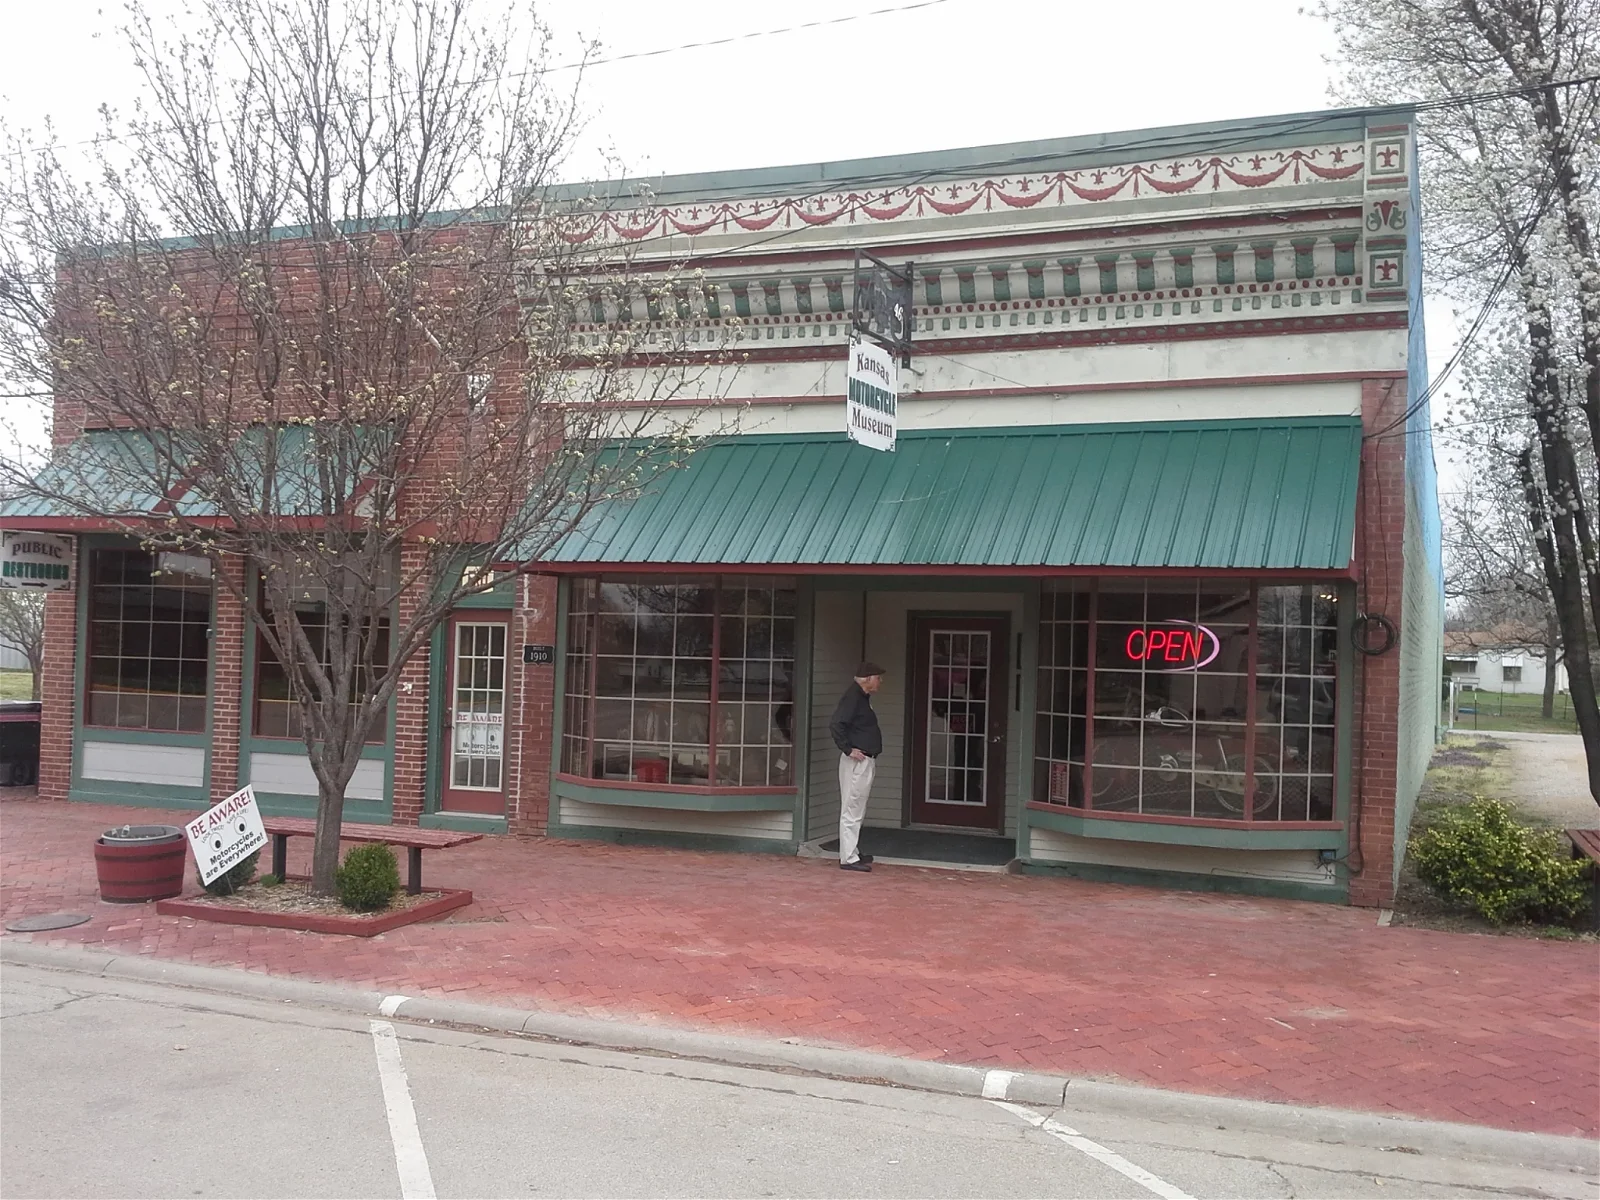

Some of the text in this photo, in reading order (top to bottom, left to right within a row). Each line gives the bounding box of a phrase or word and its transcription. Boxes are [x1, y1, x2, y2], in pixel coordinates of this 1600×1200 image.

[856, 352, 890, 386] Kansas
[848, 376, 896, 417] MOTORCYCLE
[851, 407, 893, 438] Museum
[12, 541, 63, 559] PUBLIC
[3, 561, 70, 580] RESTROOMS
[530, 652, 548, 661] 1910
[1126, 629, 1204, 662] OPEN
[190, 790, 252, 840] BE AWARE!
[205, 832, 264, 879] are Everywhere!
[209, 830, 254, 865] Motorcycles
